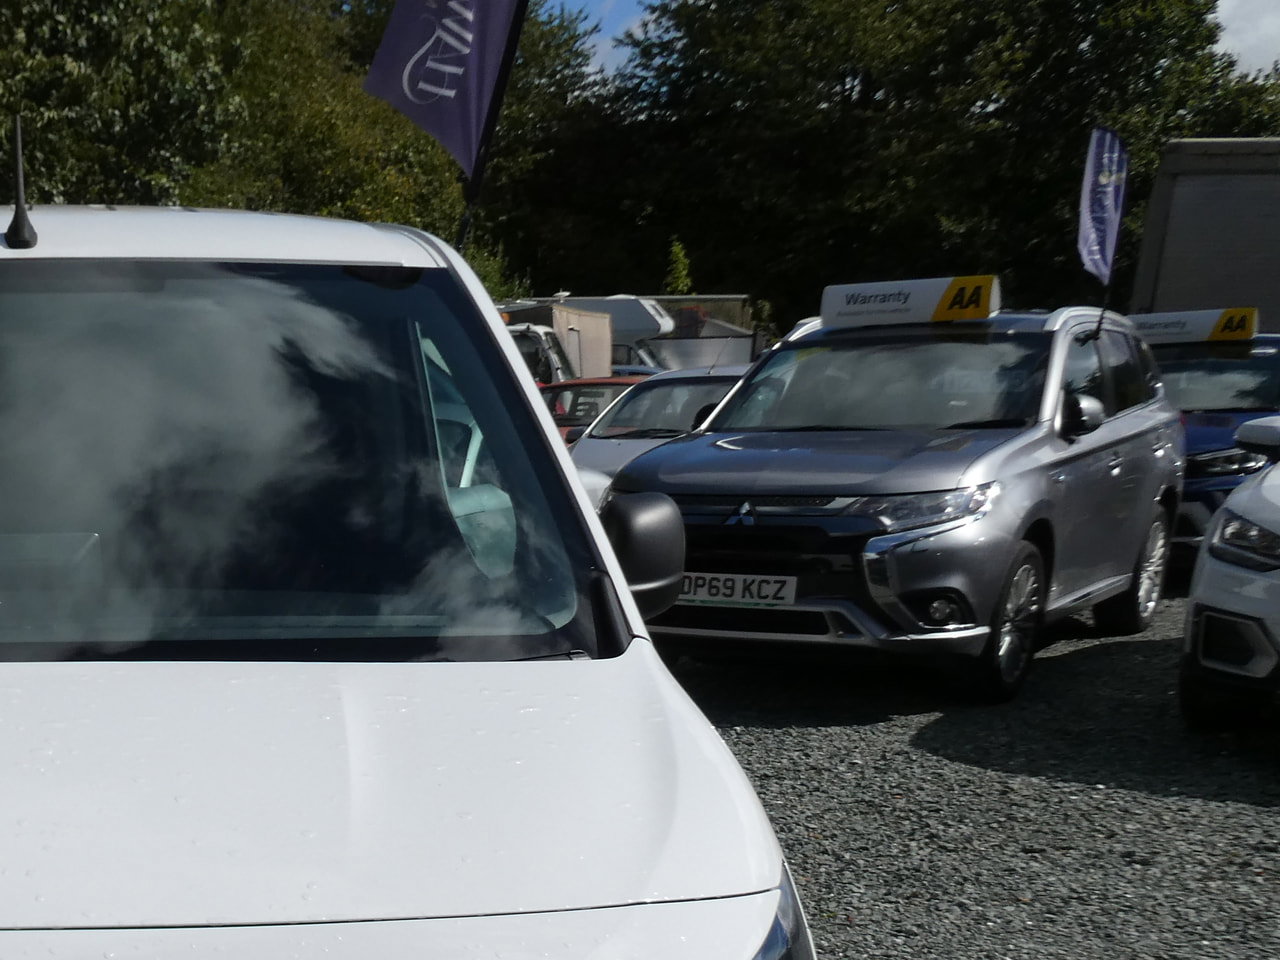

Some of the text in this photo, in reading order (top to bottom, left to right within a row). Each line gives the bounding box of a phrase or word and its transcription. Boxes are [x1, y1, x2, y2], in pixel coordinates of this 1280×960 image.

[845, 291, 911, 306] Warranty
[947, 286, 983, 310] AA
[1221, 315, 1247, 332] AA
[681, 575, 787, 600] DP69 KCZ
